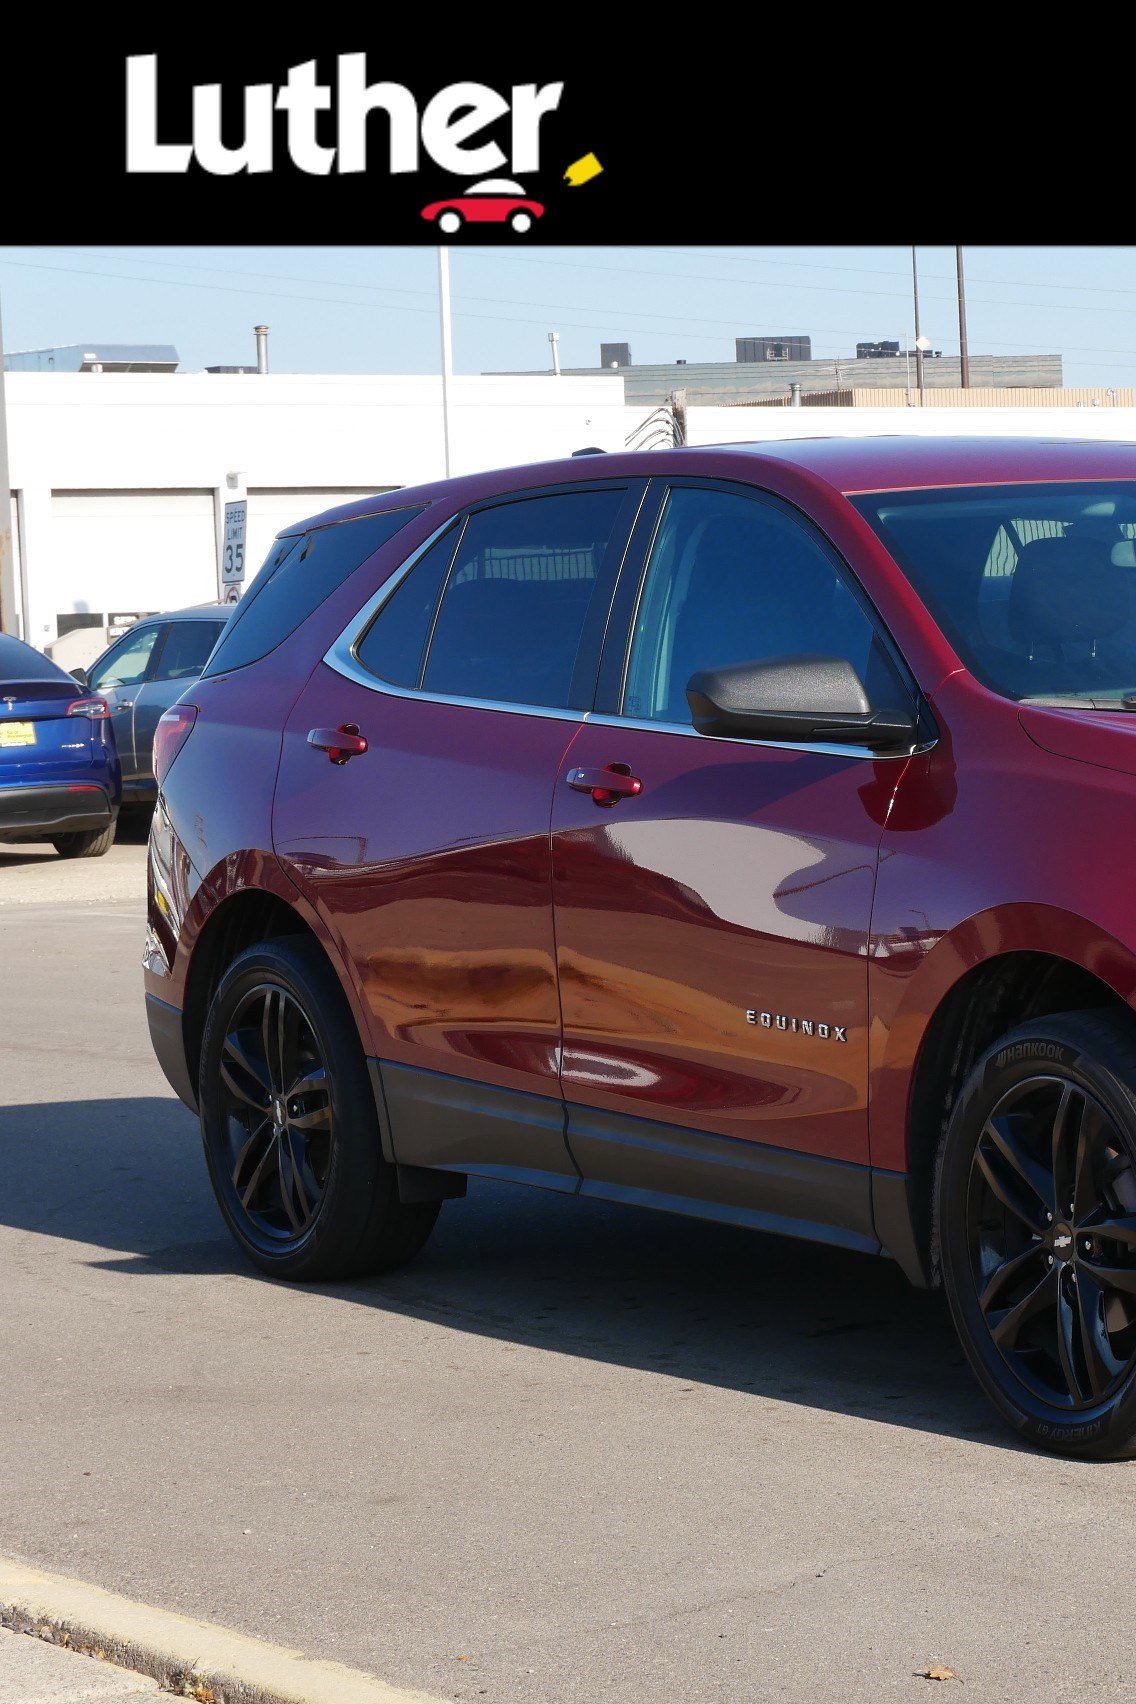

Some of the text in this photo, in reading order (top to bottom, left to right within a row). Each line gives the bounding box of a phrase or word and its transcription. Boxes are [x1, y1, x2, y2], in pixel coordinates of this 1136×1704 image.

[226, 510, 246, 524] SPEED
[227, 527, 243, 540] LIMIT
[225, 543, 244, 573] 35
[746, 1009, 847, 1042] EQUINOX
